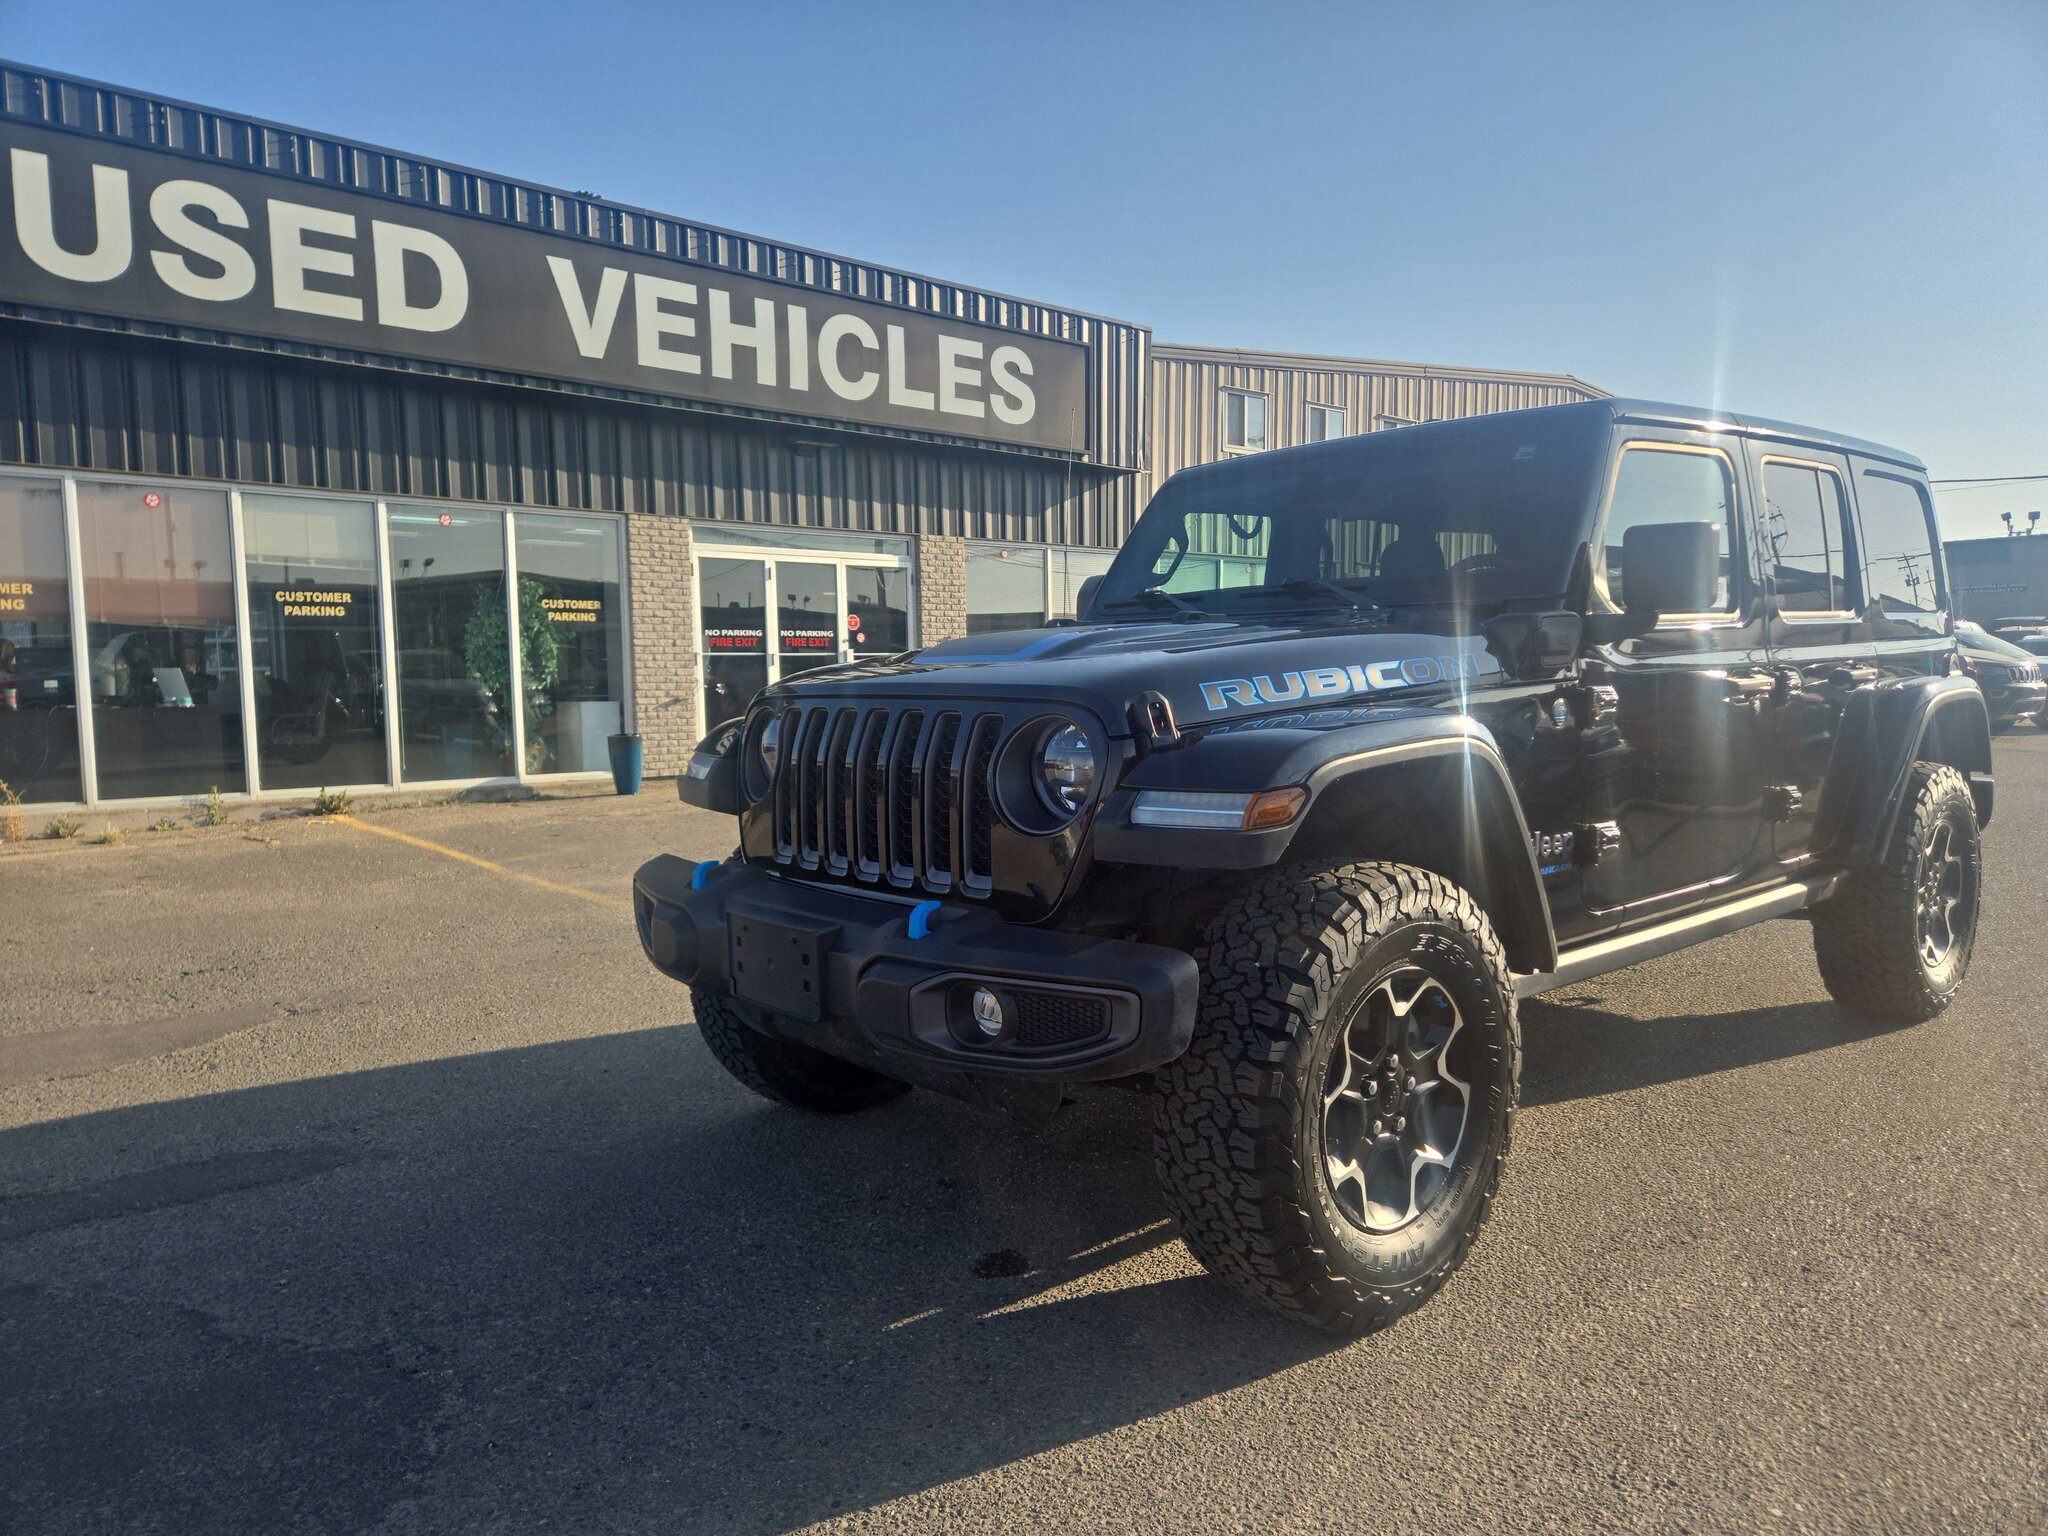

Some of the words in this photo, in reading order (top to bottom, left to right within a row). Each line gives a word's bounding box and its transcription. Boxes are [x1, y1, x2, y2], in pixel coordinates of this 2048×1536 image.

[10, 147, 470, 333] USED
[545, 254, 1036, 426] VEHICLES
[275, 590, 352, 603] CUSTOMER
[541, 598, 602, 610] CUSTOMER
[284, 604, 345, 617] PARKING
[547, 611, 597, 622] PARKING
[704, 629, 720, 637] NO
[721, 629, 763, 637] PARKING
[709, 637, 733, 647] FIRE
[734, 637, 758, 647] EXIT
[785, 637, 807, 647] FIRE
[808, 637, 831, 647] EXIT
[1198, 653, 1480, 711] RUBICON
[1531, 830, 1574, 861] Jeep
